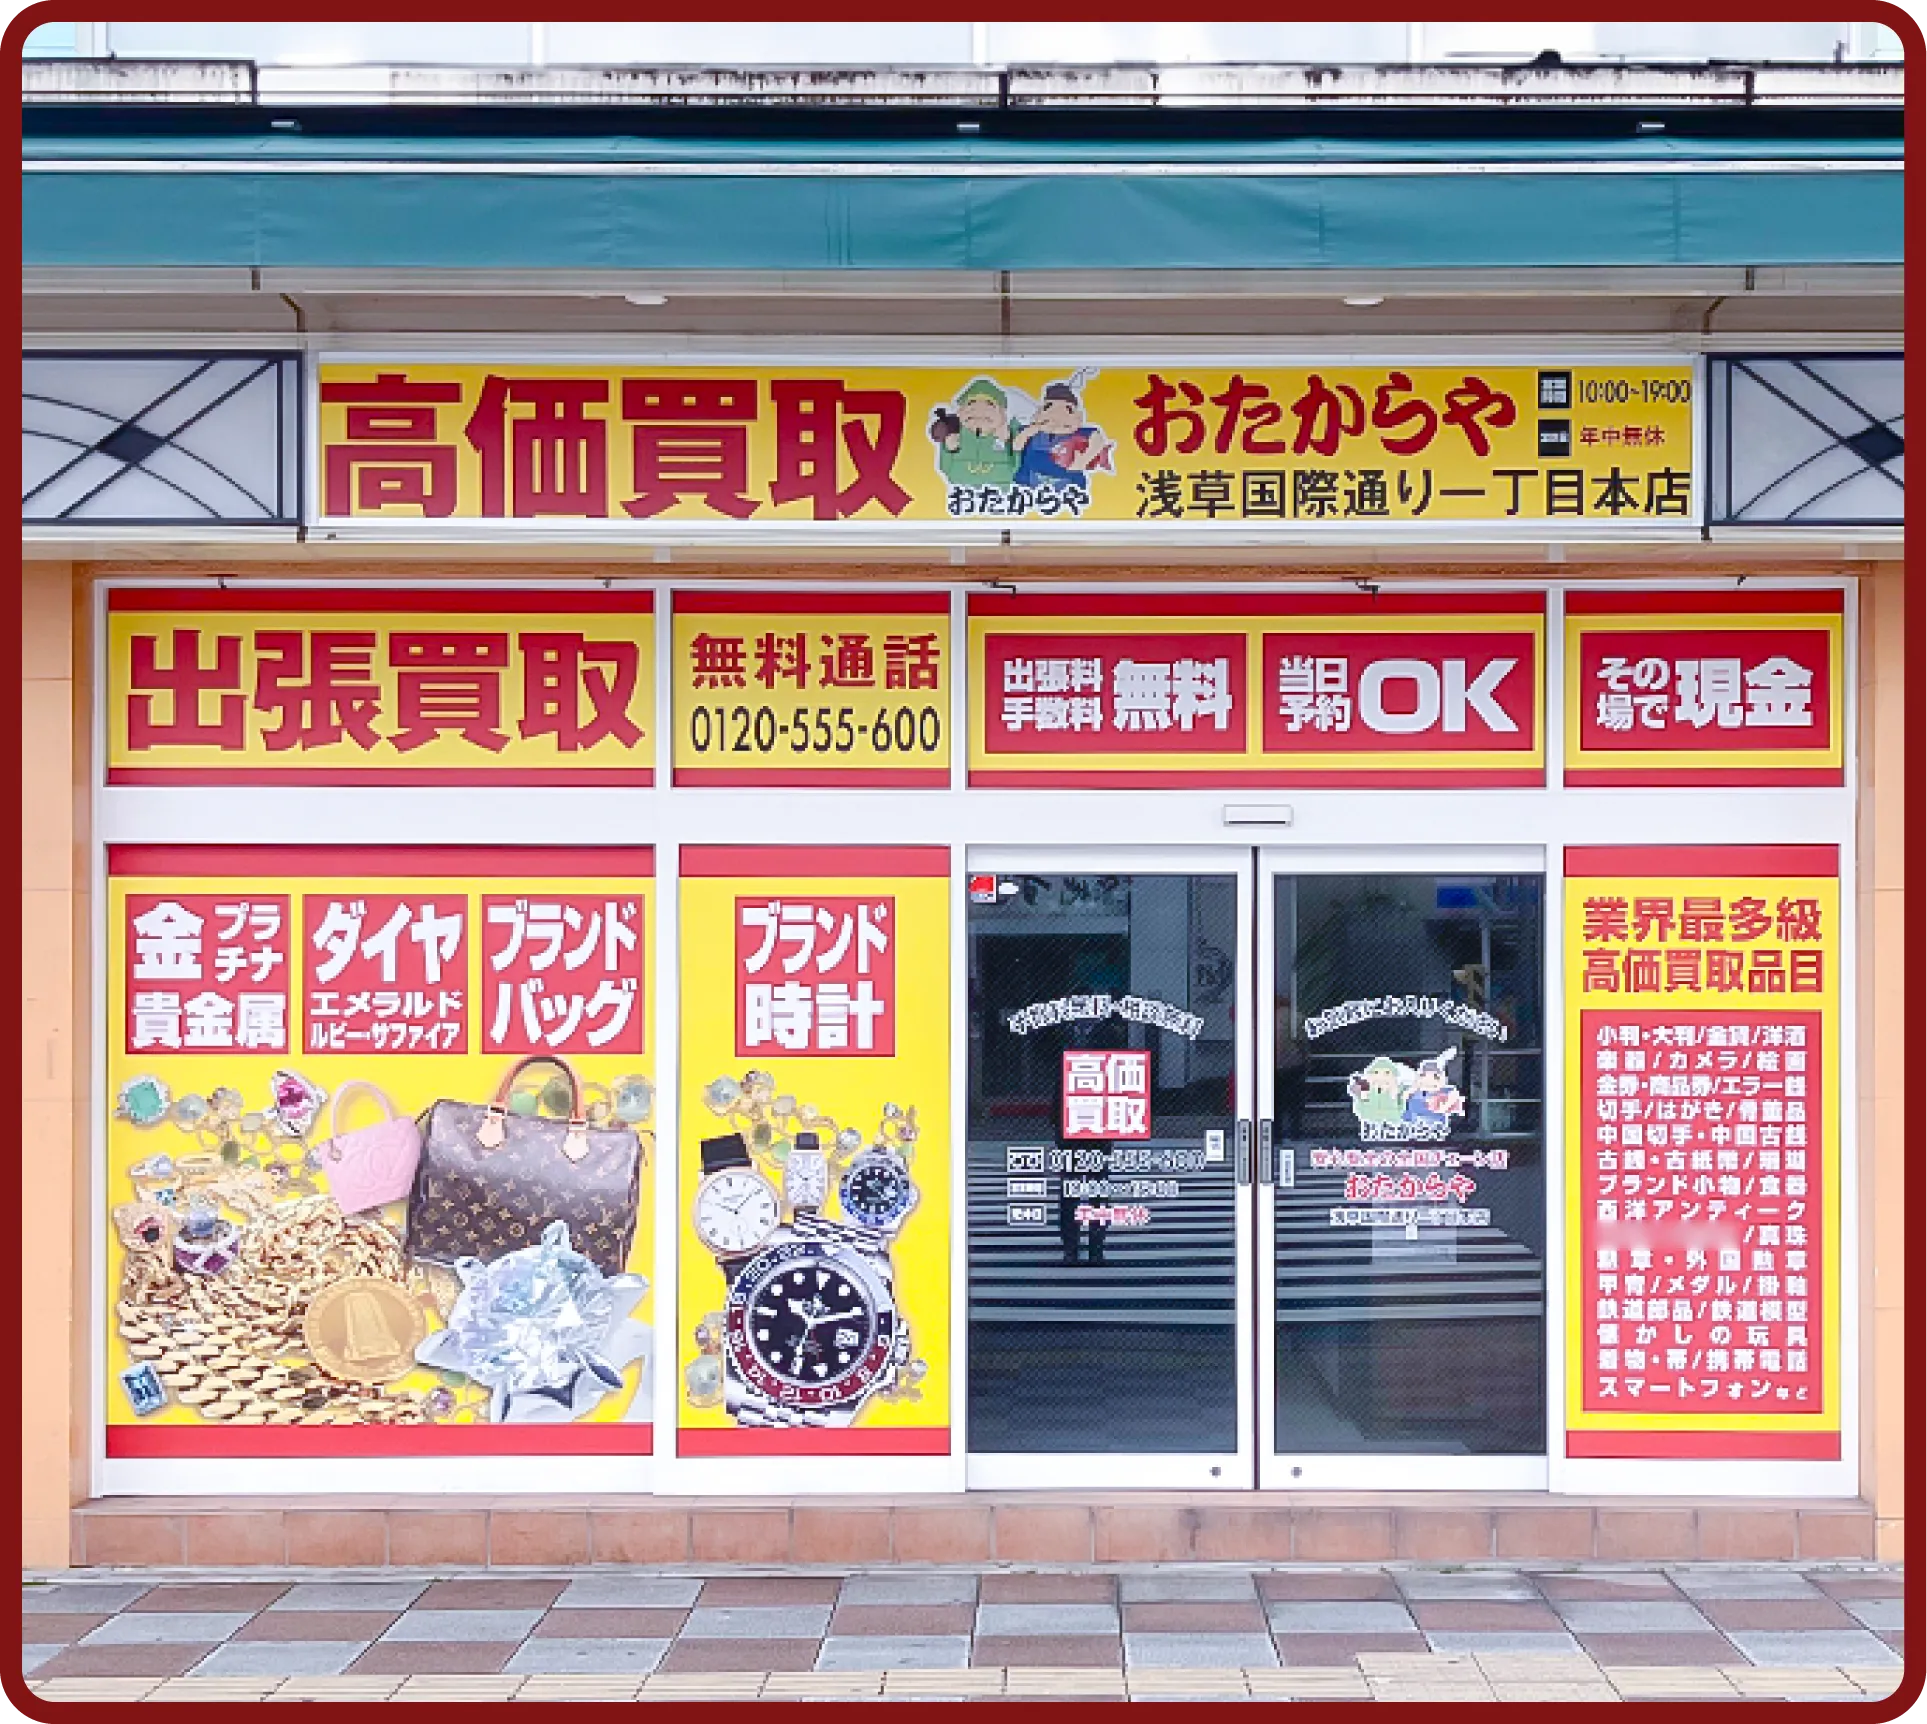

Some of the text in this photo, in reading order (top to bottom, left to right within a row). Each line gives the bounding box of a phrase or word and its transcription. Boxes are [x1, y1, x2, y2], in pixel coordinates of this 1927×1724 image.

[1134, 372, 1516, 458] おたからや
[1580, 425, 1666, 447] 年中無休
[321, 374, 913, 519] 高価買取
[948, 486, 1089, 516] おたからや
[1135, 469, 1690, 519] 浅草国際通り一丁目本店
[690, 632, 940, 690] 無料通話
[1003, 657, 1103, 694] 出張料
[1279, 657, 1346, 692] 当日
[1597, 656, 1666, 691] その
[125, 630, 645, 752] 出張買取
[1001, 696, 1103, 732] 手数料
[1112, 658, 1233, 732] 無料
[1279, 695, 1351, 732] 予約
[1359, 657, 1519, 733] OK
[1597, 694, 1665, 730] 場で
[1673, 656, 1814, 729] 現金
[691, 706, 940, 753] 0120-555-600
[133, 901, 204, 980] 金
[214, 902, 282, 940] プラ
[488, 900, 638, 974] ブランド
[741, 900, 888, 974] ブランド
[1583, 897, 1823, 942] 業界最多級
[214, 946, 284, 983] チナ
[312, 902, 464, 984] ダイヤ
[1583, 948, 1823, 992] 高価買取品目
[131, 991, 286, 1048] 貴金属
[310, 991, 464, 1018] エメラルド
[490, 977, 638, 1047] バッグ
[744, 981, 885, 1050] 時計
[1066, 1053, 1147, 1093] 高価
[1066, 1095, 1148, 1135] 買取
[1345, 1172, 1476, 1203] おたからや
